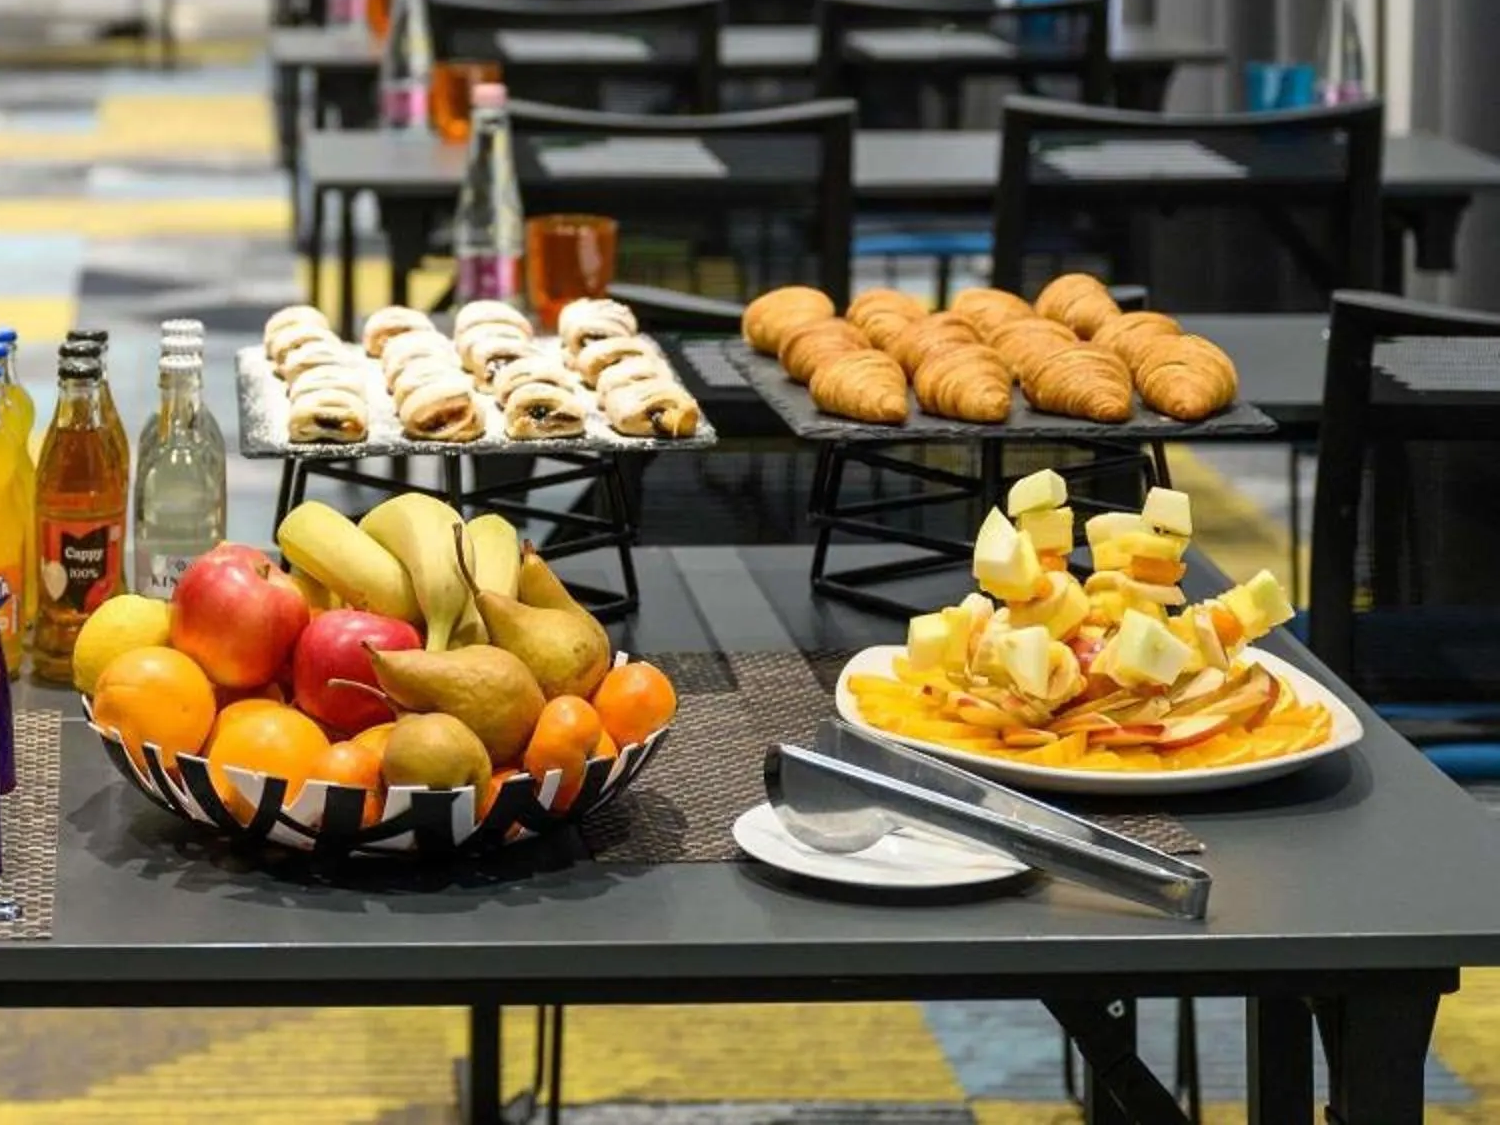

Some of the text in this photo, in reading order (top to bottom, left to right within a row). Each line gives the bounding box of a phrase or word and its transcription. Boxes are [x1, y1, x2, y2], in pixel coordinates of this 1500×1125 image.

[65, 547, 104, 562] Cappy
[69, 568, 99, 580] 100%
[151, 575, 180, 587] KIN
